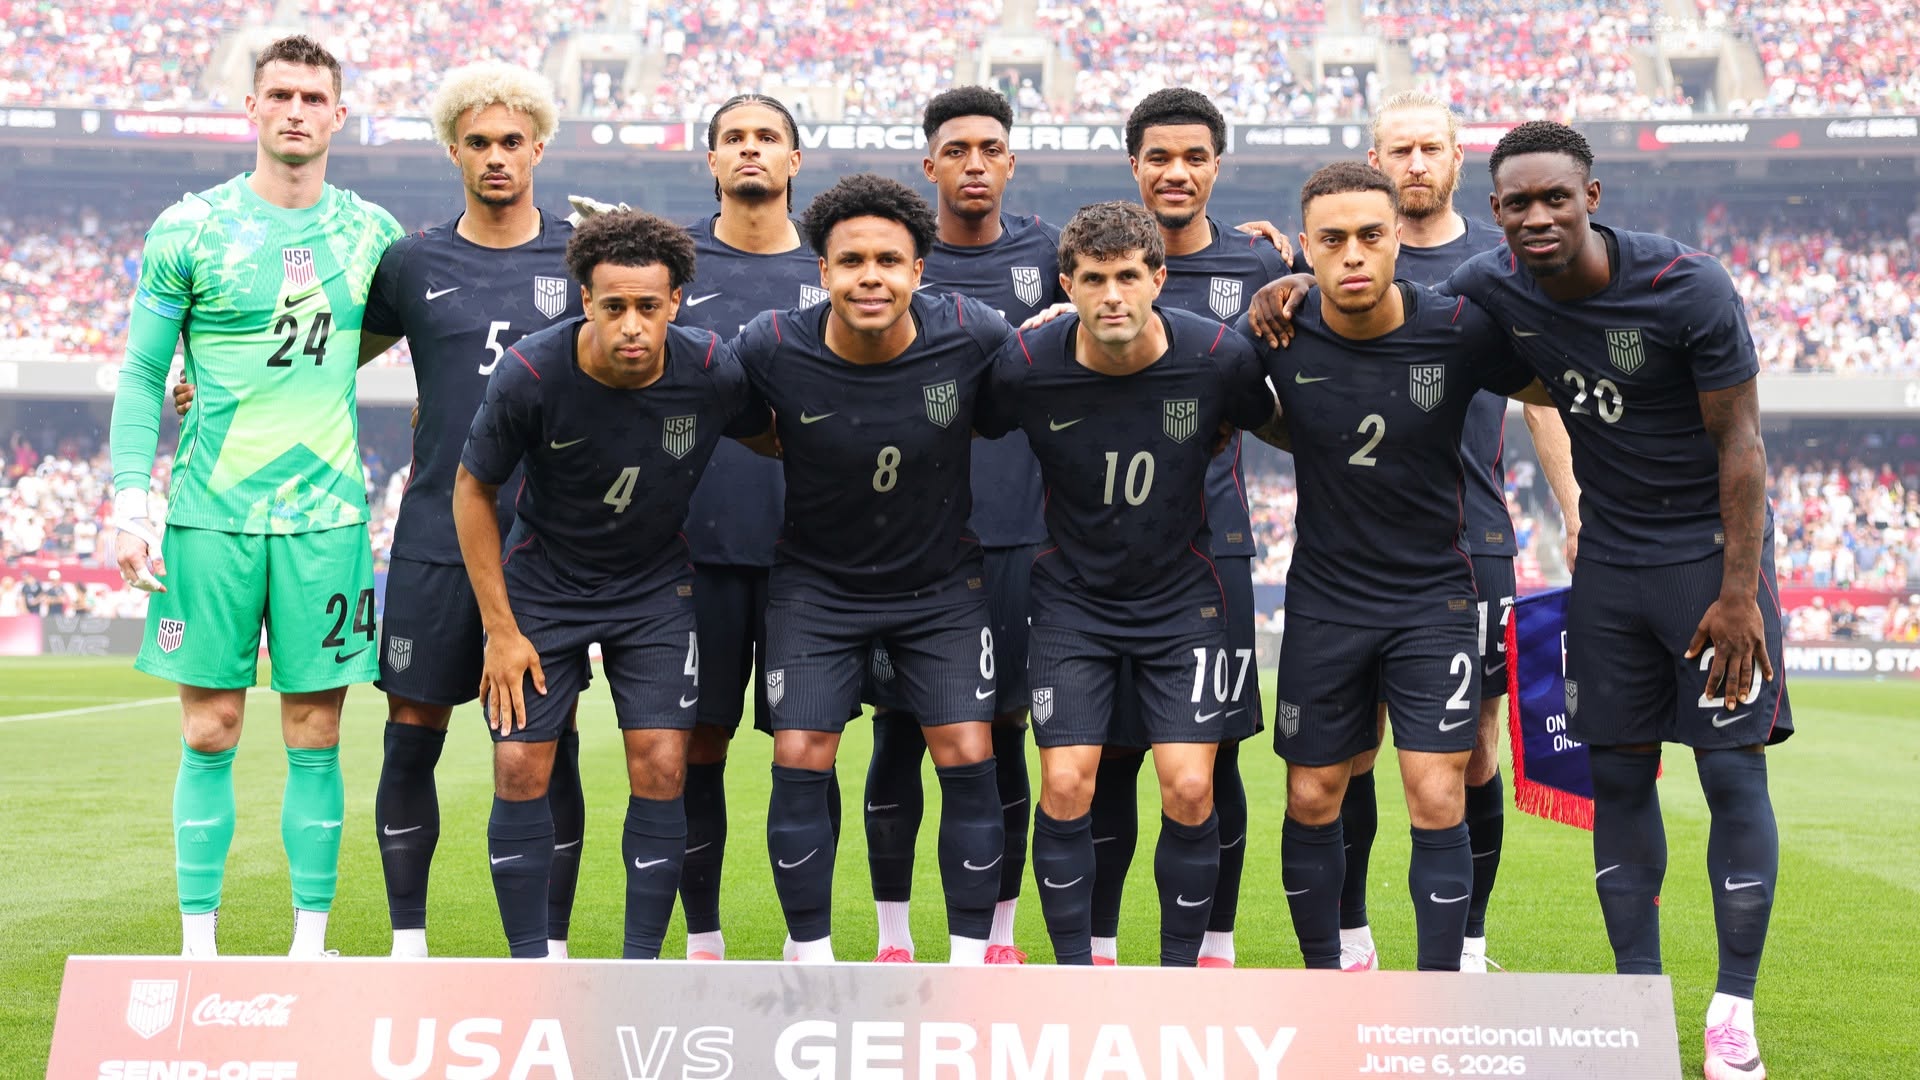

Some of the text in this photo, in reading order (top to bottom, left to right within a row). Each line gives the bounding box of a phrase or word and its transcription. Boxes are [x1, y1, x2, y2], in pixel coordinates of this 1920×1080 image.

[284, 250, 311, 265] USA
[537, 279, 565, 296] USA
[1014, 269, 1039, 284] USA
[1213, 280, 1240, 297] USA
[266, 312, 332, 367] 24
[478, 321, 511, 376] 5
[1609, 331, 1639, 349] USA
[1412, 367, 1442, 385] USA
[926, 383, 955, 403] USA
[1563, 369, 1625, 424] 20
[1166, 402, 1196, 419] USA
[666, 418, 694, 434] USA
[1348, 413, 1386, 467] 2
[872, 445, 902, 493] 8
[1103, 450, 1155, 507] 10
[603, 466, 641, 514] 4
[161, 620, 183, 634] USA
[322, 588, 376, 649] 24
[391, 639, 411, 653] USA
[979, 626, 995, 681] 8
[683, 631, 699, 687] 4
[767, 671, 782, 687] USA
[1191, 647, 1229, 703] 10
[1445, 652, 1472, 710] 2
[1033, 690, 1051, 704] USA
[1281, 703, 1298, 719] USA
[133, 982, 175, 1006] USA
[1357, 1023, 1640, 1049] International Match
[370, 1017, 1298, 1080] USA VS GERMANY
[98, 1060, 299, 1080] SEND-OFF
[1359, 1053, 1527, 1077] June 6, 2026
